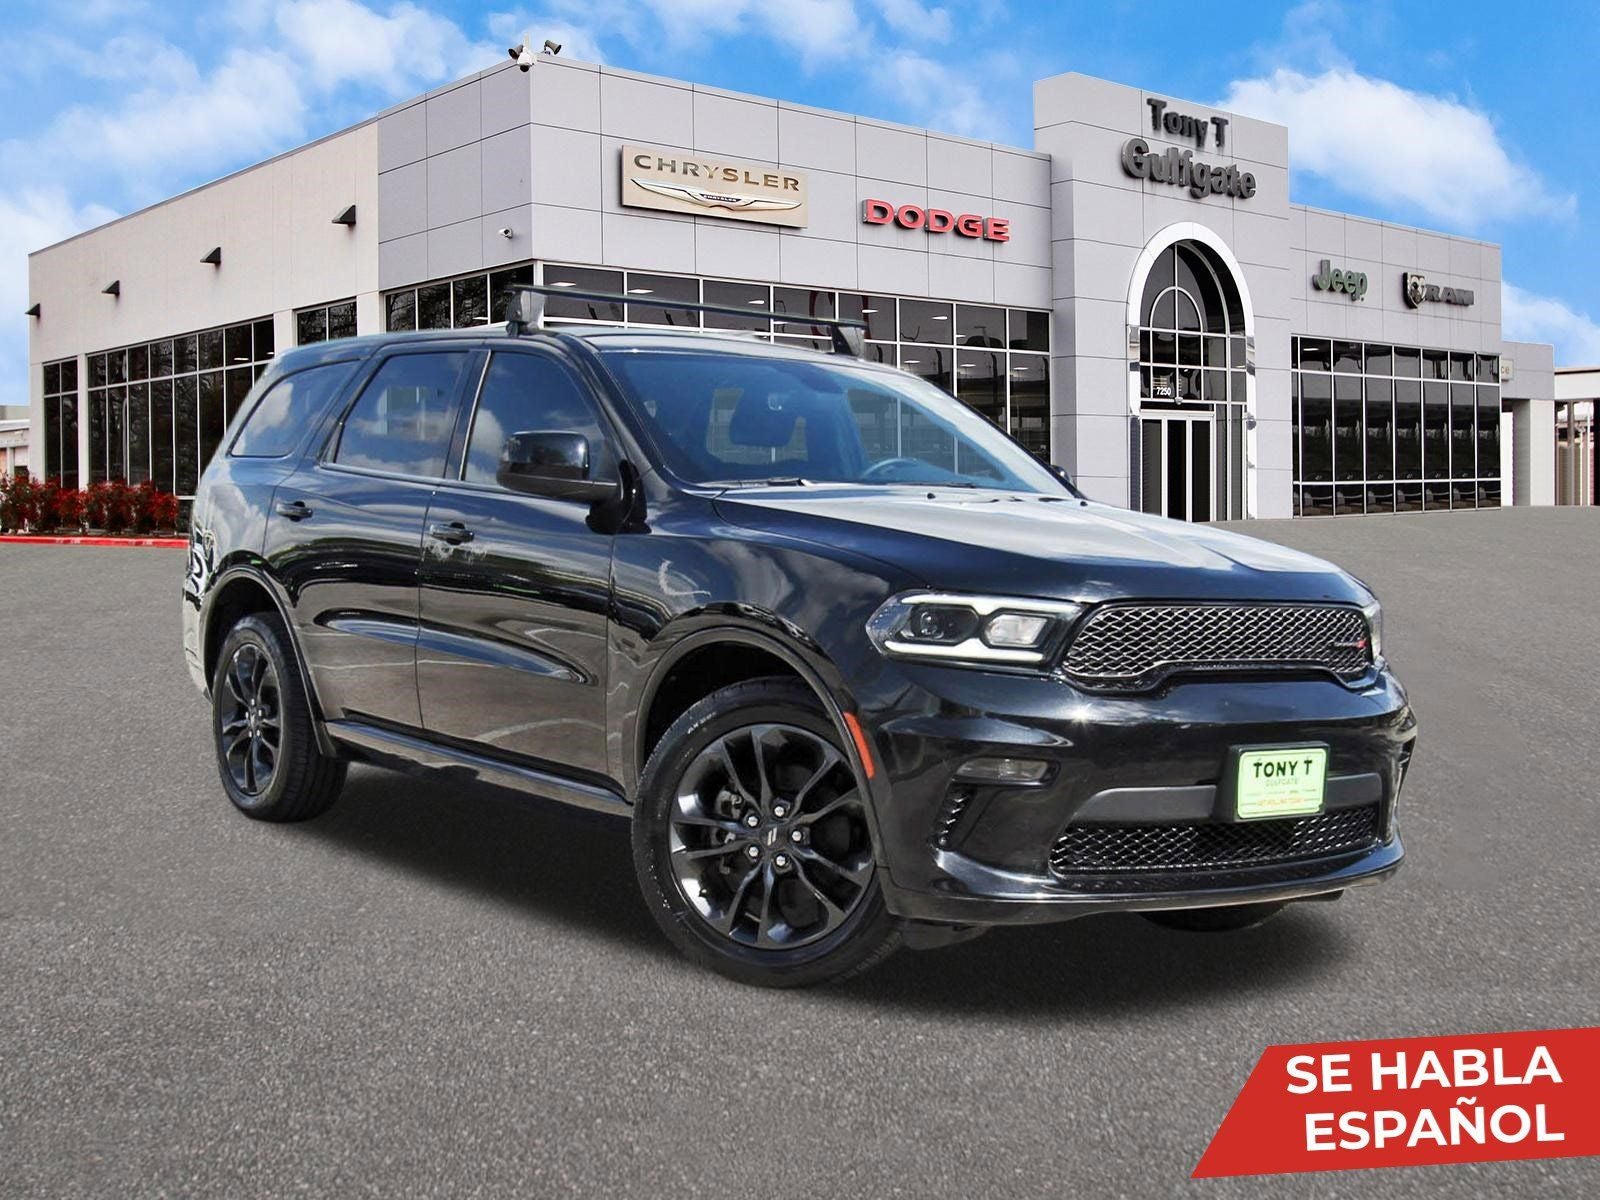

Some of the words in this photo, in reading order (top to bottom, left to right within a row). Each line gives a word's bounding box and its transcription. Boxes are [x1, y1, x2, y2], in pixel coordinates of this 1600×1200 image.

[1147, 98, 1208, 148] Tony
[1211, 116, 1229, 147] T
[633, 153, 801, 192] CHRYSLER
[1121, 137, 1256, 199] Gulfgate
[863, 198, 1010, 242] DODGE
[1313, 259, 1368, 302] Jeep
[1425, 284, 1474, 306] RAM
[1156, 387, 1171, 396] 7250
[1253, 760, 1298, 778] TONY
[1304, 759, 1312, 775] T
